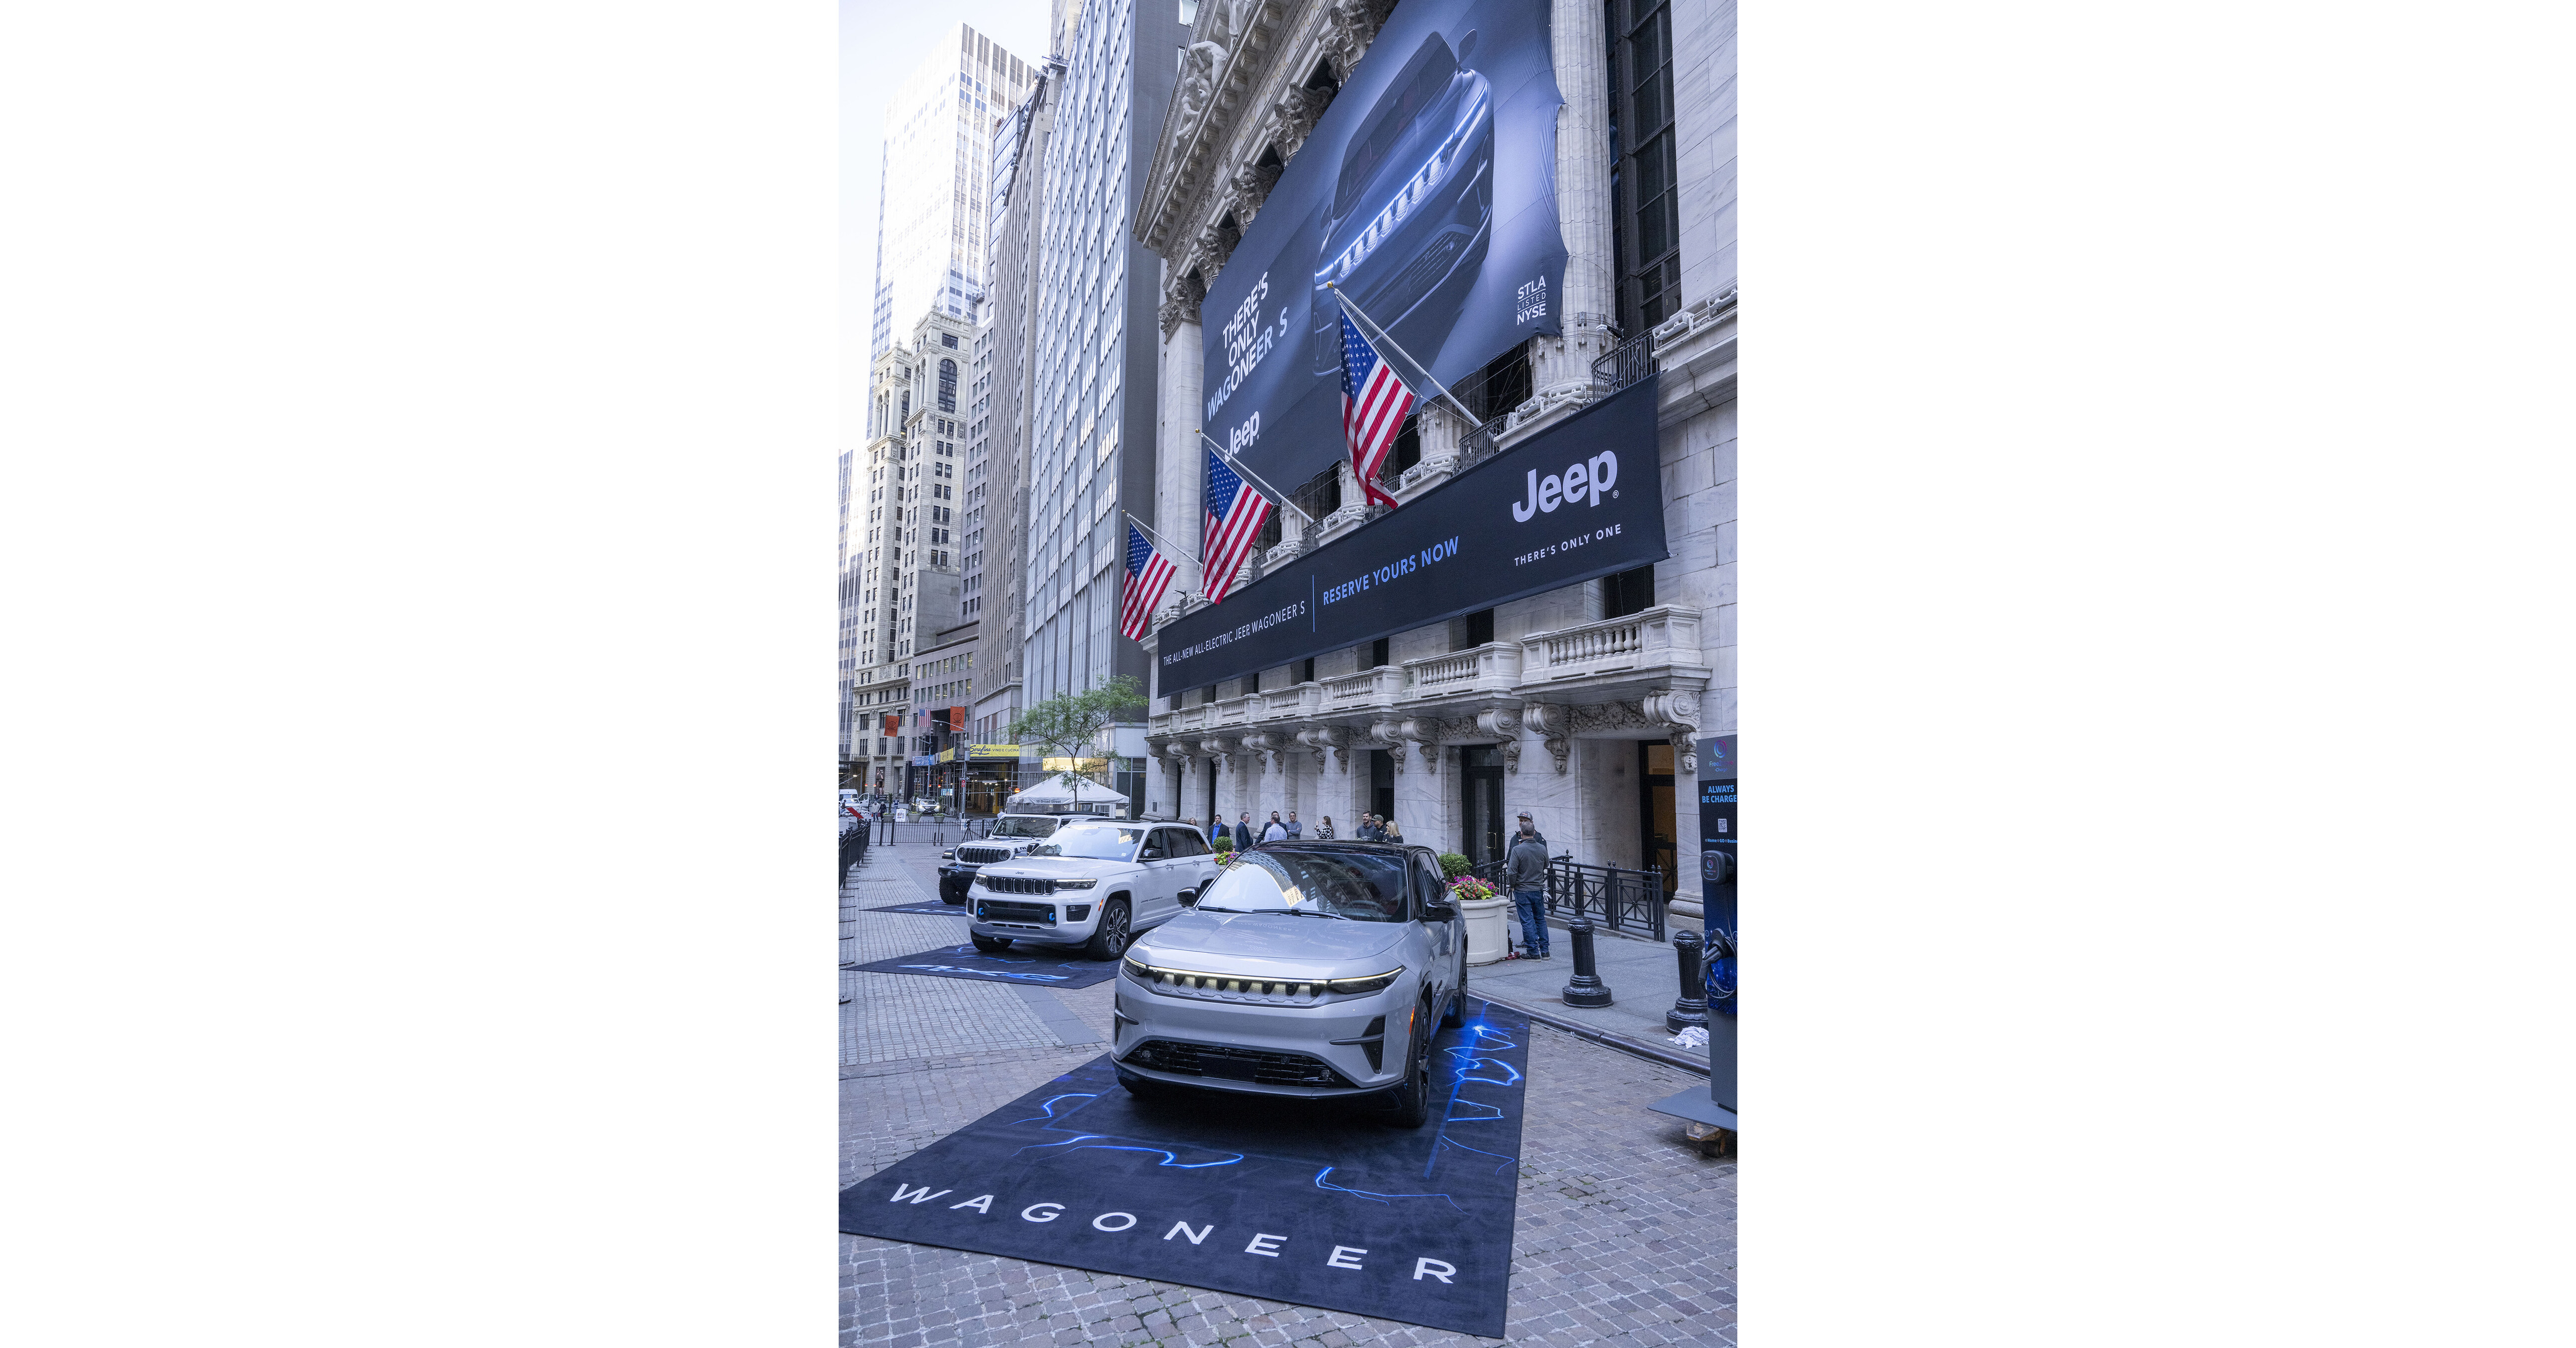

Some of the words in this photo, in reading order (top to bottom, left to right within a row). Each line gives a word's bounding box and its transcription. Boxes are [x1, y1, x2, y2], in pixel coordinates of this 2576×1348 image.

[1239, 104, 1257, 149] NEW
[1262, 49, 1289, 106] YORK
[1222, 271, 1268, 349] THERE'S
[1517, 292, 1546, 311] LISTED
[1517, 303, 1546, 326] NYSE
[1518, 275, 1546, 300] STLA
[1207, 325, 1273, 422] WAGONEER
[1279, 307, 1288, 337] S
[1228, 310, 1260, 367] ONLY
[1323, 574, 1369, 606] RESERVE
[1373, 554, 1416, 586] YOURS
[1421, 536, 1459, 567] NOW
[1514, 545, 1556, 566] THERE'S
[1561, 533, 1590, 551] ONLY
[1596, 523, 1621, 540] ONE
[1163, 655, 1172, 666] THE
[1173, 646, 1194, 663] ALL-NEW
[1195, 631, 1233, 655] ALL-ELECTRIC
[1251, 604, 1297, 633] WAGONEER
[1300, 600, 1305, 615] S
[970, 745, 991, 755] Serafina
[1707, 785, 1734, 793] ALWAYS
[890, 1183, 1456, 1284] WAGONEER
